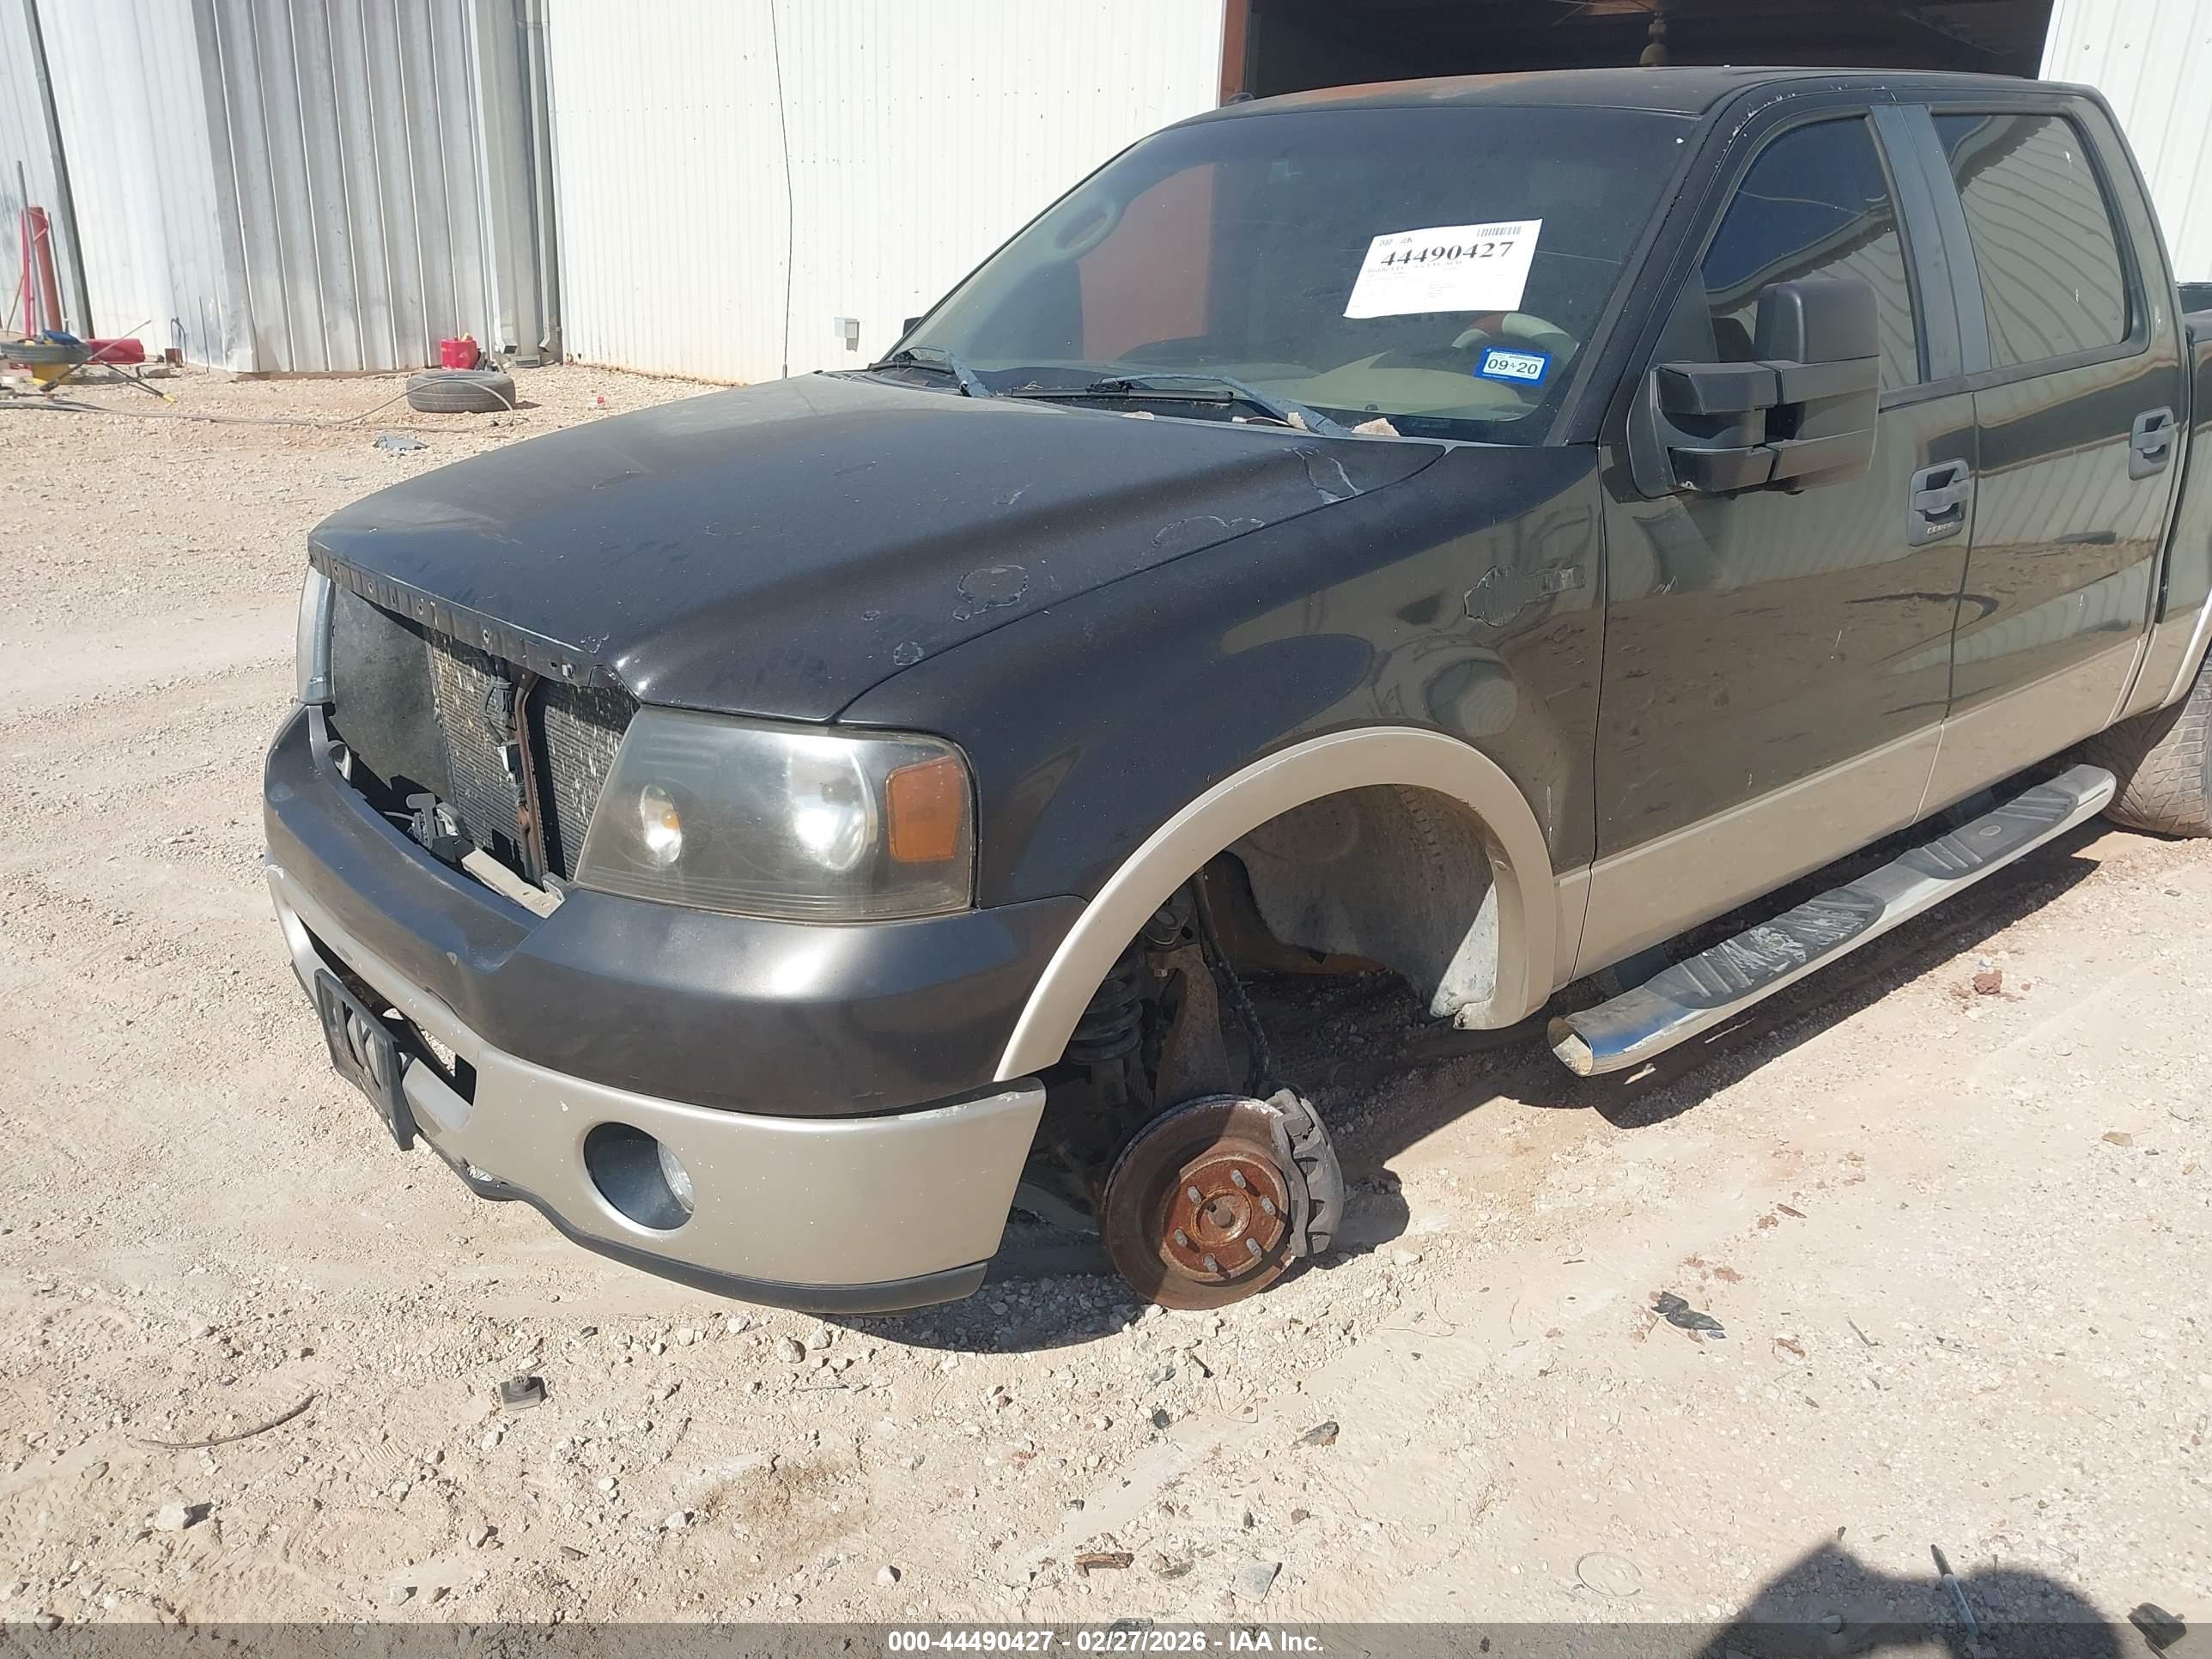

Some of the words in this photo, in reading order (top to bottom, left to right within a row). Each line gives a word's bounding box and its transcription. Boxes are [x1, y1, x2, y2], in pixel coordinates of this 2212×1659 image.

[1381, 241, 1514, 265] 44490427
[1488, 359, 1508, 370] 09
[1516, 362, 1538, 374] 20
